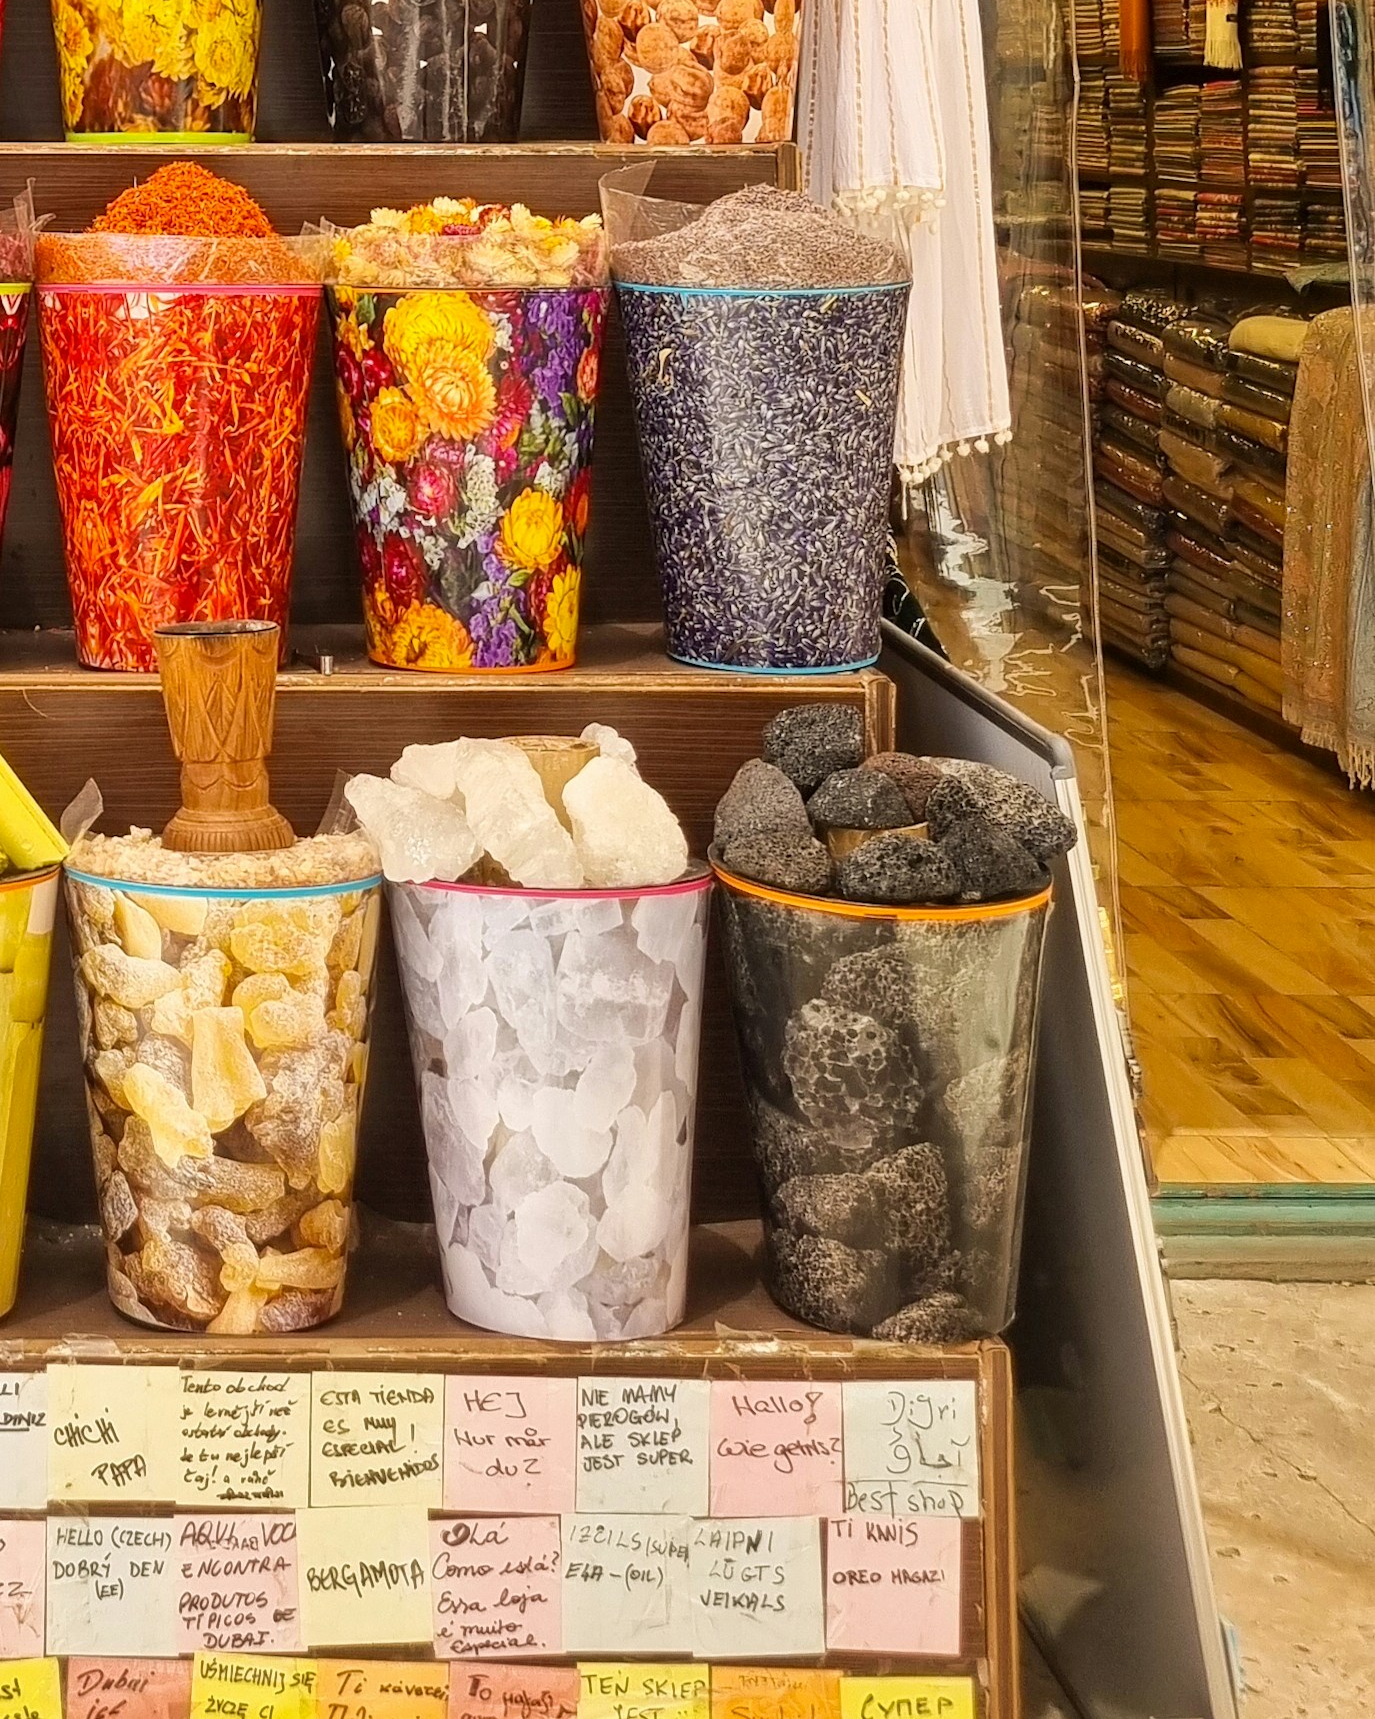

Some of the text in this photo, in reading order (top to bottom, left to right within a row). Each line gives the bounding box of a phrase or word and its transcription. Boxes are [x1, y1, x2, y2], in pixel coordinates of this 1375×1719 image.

[320, 1389, 361, 1406] ESTA
[581, 1384, 677, 1407] NIE MAMY
[581, 1428, 682, 1450] ALE SKLEP
[91, 1454, 147, 1487] PAPA
[583, 1449, 693, 1472] JEST SUPER
[908, 1485, 964, 1518] shop
[56, 1526, 172, 1551] HELLO (CZECH)
[694, 1528, 774, 1554] LAIPNI
[53, 1552, 164, 1579] DOBRÝ DEN
[181, 1556, 291, 1578] ENCONTRA
[307, 1558, 424, 1598] BERGAMOTA
[432, 1551, 493, 1580] Como
[832, 1569, 945, 1586] OREO MAGAZI
[179, 1592, 268, 1614] PRODUTOS
[200, 1657, 317, 1694] UŚMIECHNIJ SIĘ
